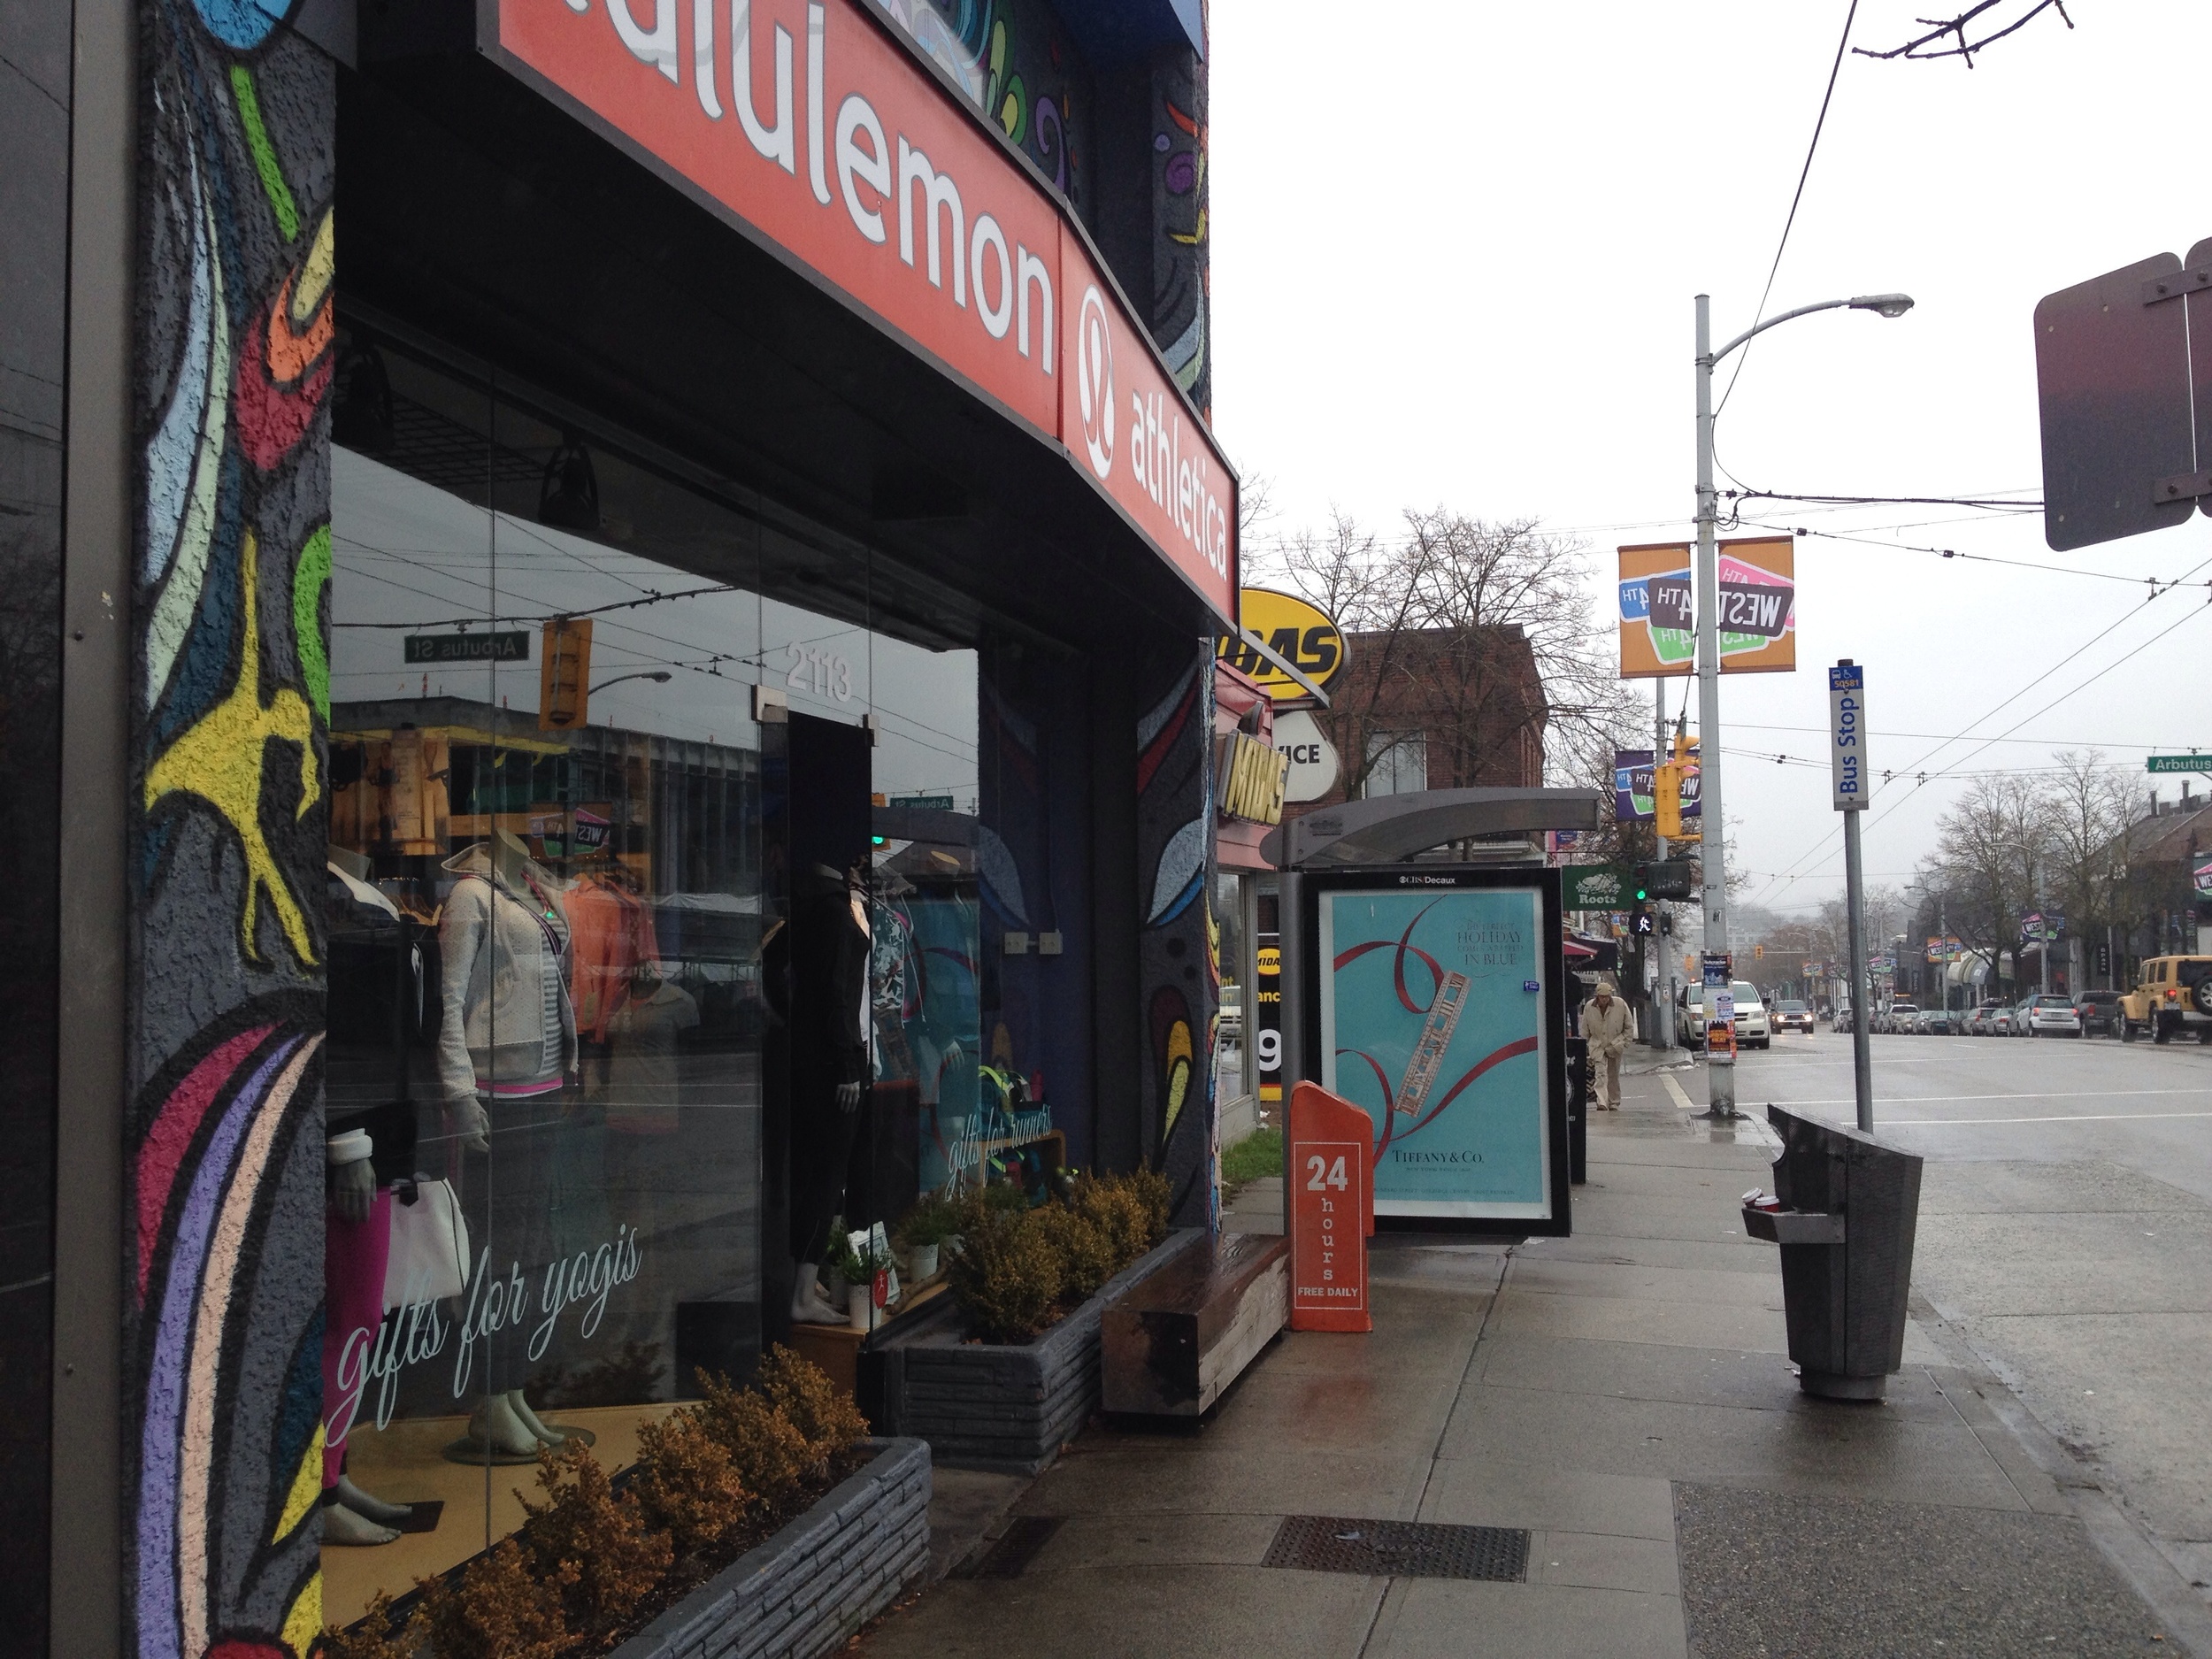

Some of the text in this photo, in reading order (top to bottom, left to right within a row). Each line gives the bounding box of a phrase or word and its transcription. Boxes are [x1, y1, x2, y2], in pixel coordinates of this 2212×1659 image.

[565, 0, 1054, 376] ululemon
[1131, 388, 1227, 583] athletica
[1222, 625, 1338, 676] DAS
[785, 641, 852, 703] 2113
[1834, 679, 1859, 688] 50581
[1278, 744, 1320, 764] ICE
[1838, 697, 1859, 794] Bus Stop
[2154, 758, 2212, 771] Arbutus
[1578, 894, 1617, 904] Roots
[1457, 931, 1522, 943] HOLIDAY
[1257, 956, 1280, 966] IDA
[1464, 954, 1517, 965] IN BLUE
[1259, 1029, 1281, 1071] 9
[944, 1103, 1053, 1202] gifts for runners
[1306, 1155, 1348, 1191] 24
[1321, 1197, 1334, 1281] hours
[1297, 1286, 1359, 1297] FREE DAILY
[325, 1224, 643, 1447] gifts for yogis
